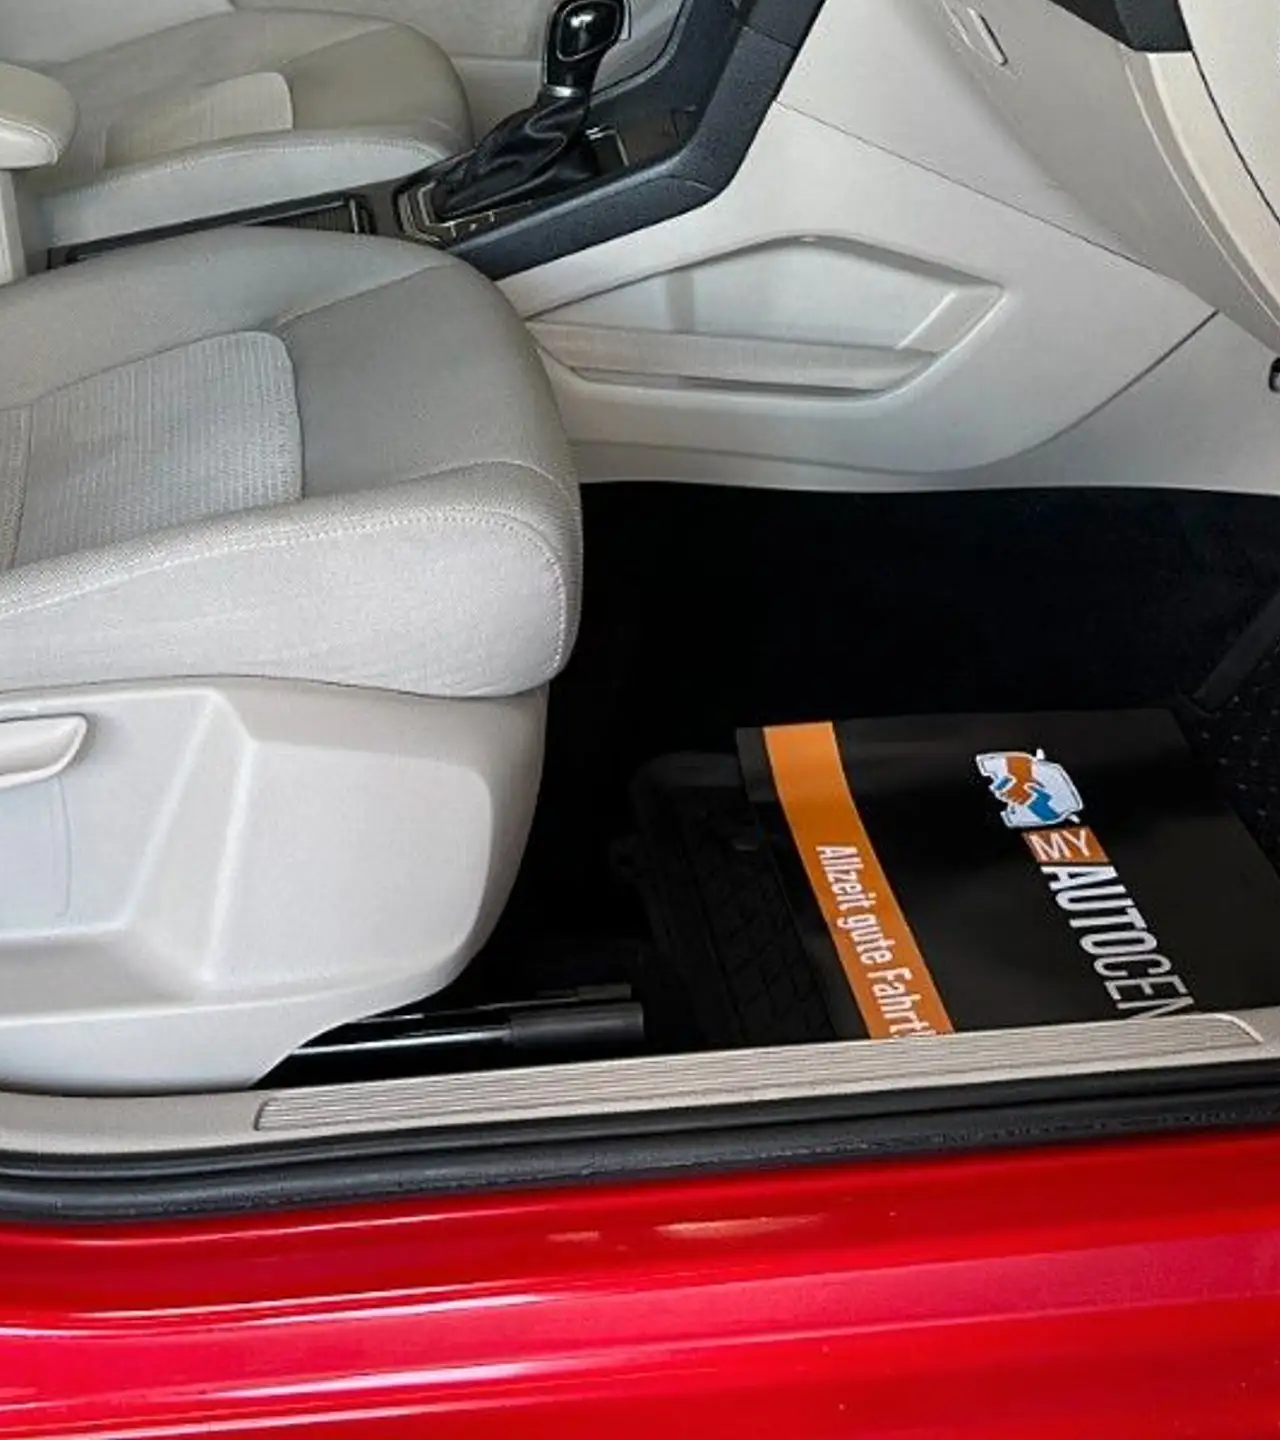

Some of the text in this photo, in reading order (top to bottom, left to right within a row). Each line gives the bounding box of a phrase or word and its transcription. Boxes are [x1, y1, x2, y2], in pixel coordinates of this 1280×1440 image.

[1028, 829, 1091, 862] MY
[815, 844, 877, 912] Allzeit
[836, 913, 896, 965] gute
